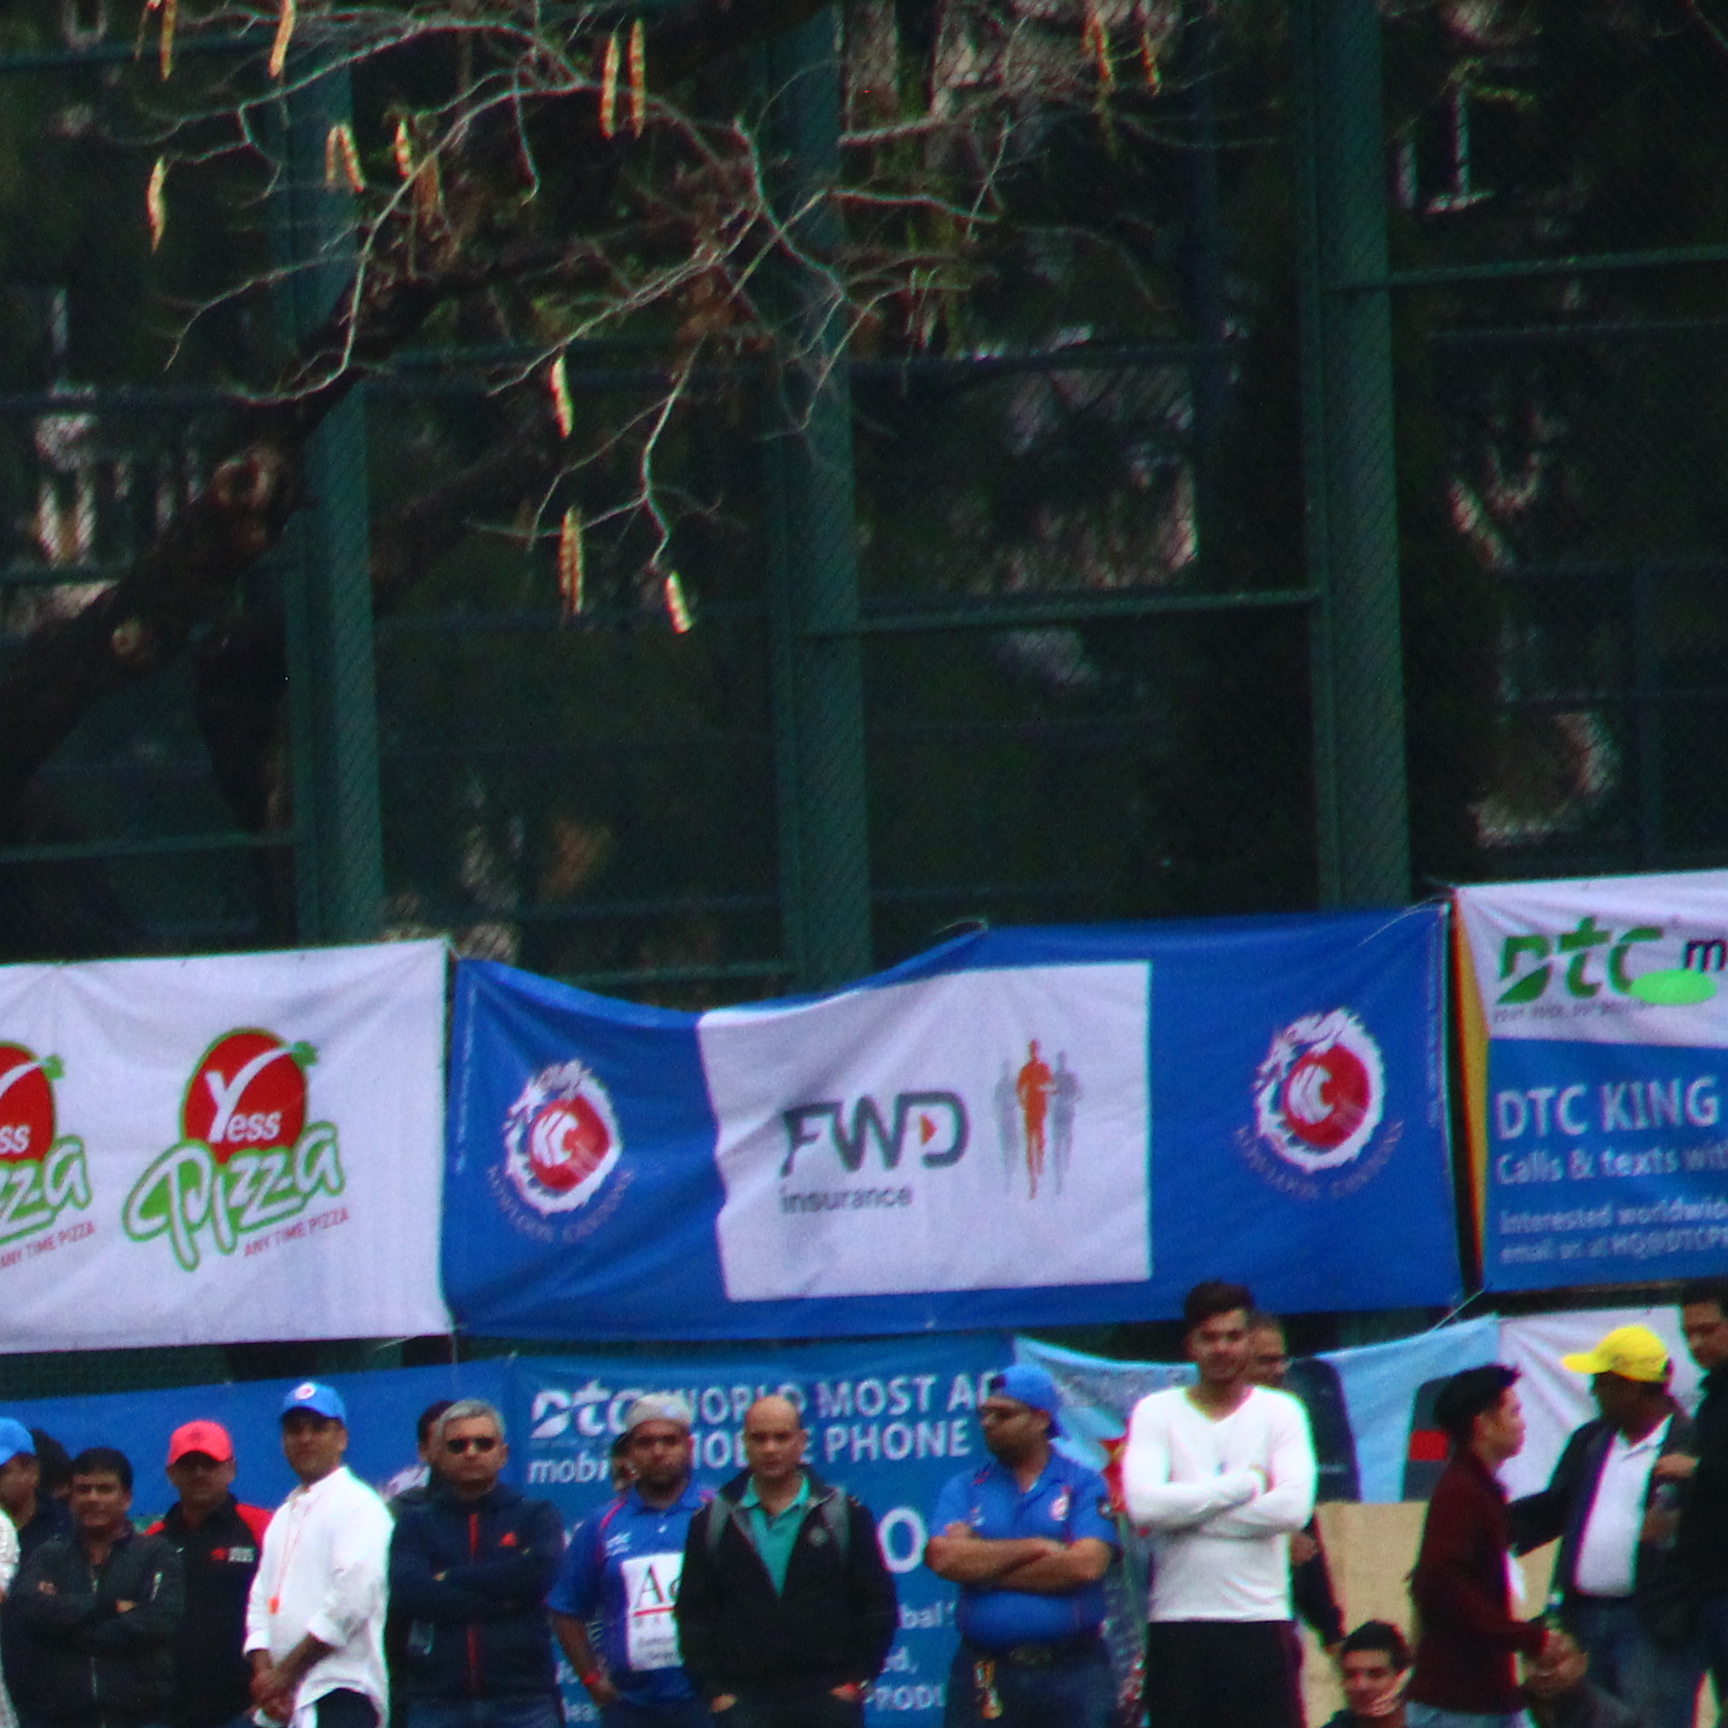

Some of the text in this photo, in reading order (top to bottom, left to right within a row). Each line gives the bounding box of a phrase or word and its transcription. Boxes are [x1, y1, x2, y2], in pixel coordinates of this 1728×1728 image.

[204, 1048, 294, 1143] Yess
[1495, 1075, 1719, 1140] DTC KING
[779, 1091, 970, 1178] FWD
[1495, 1149, 1563, 1185] Calls
[1599, 1145, 1679, 1178] texts
[126, 1126, 345, 1270] Pizza
[780, 1184, 913, 1213] insurance
[309, 1207, 350, 1235] PIZZA
[816, 1374, 938, 1419] MOST
[824, 1419, 973, 1464] PHONE
